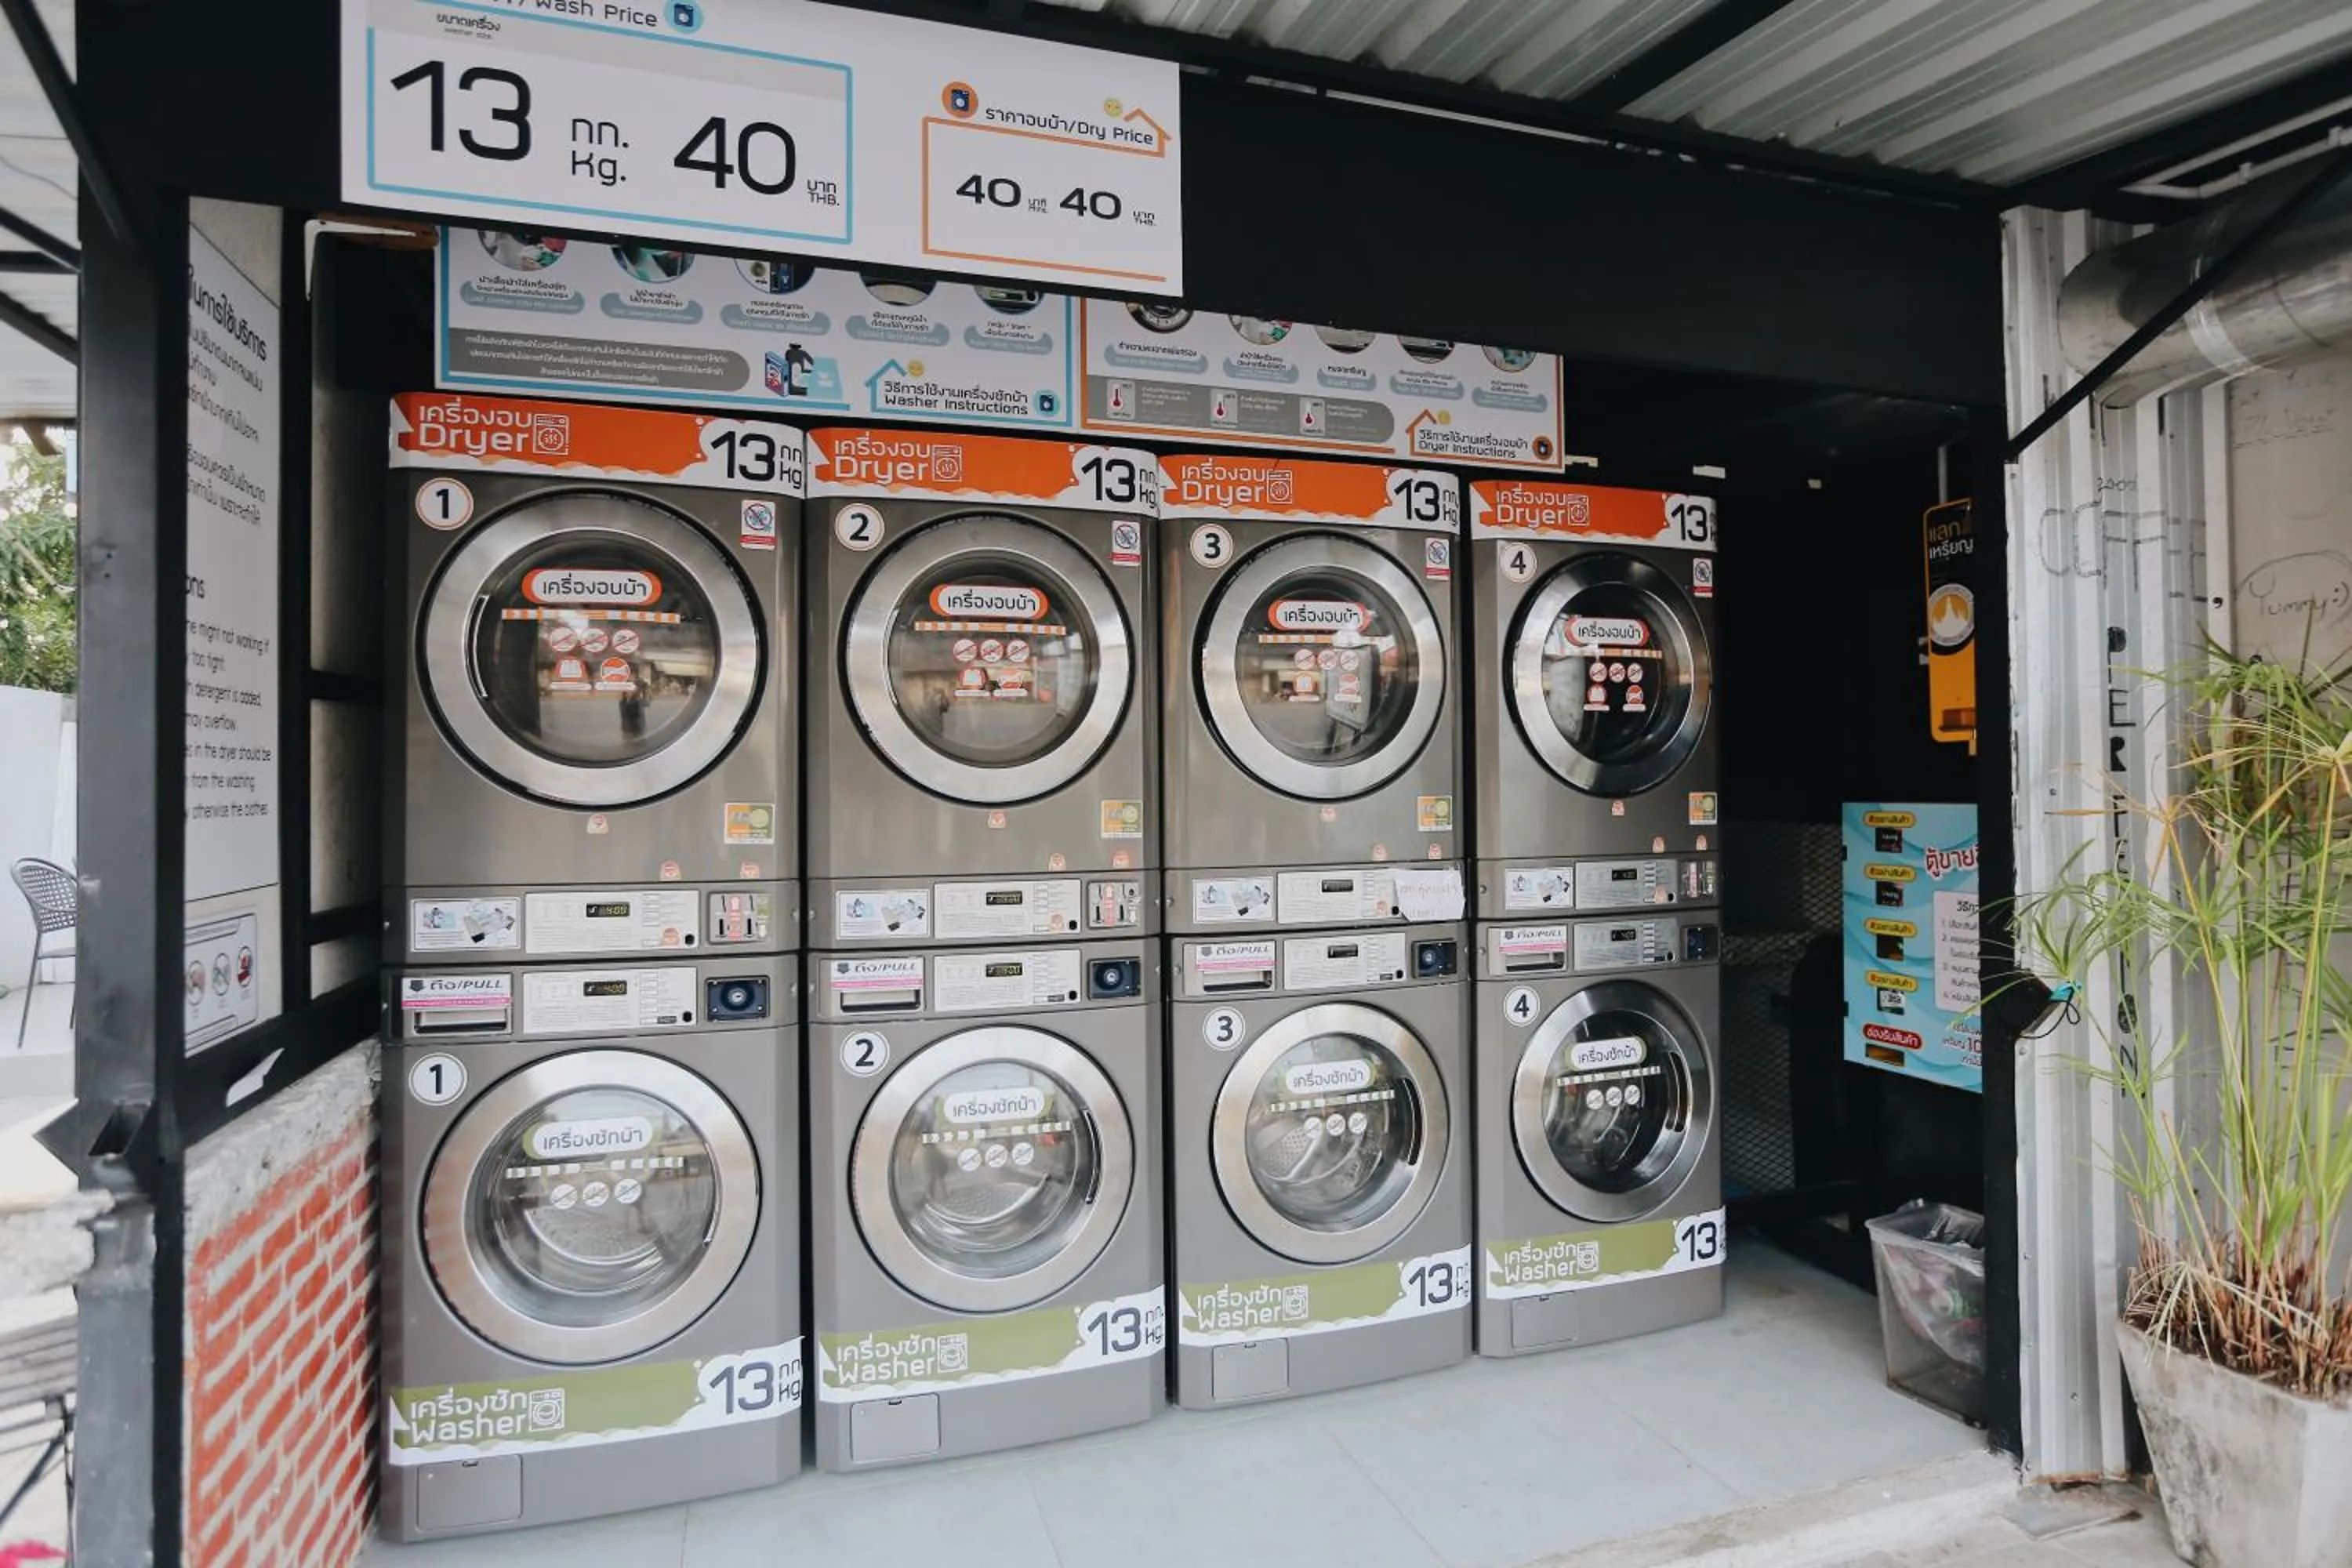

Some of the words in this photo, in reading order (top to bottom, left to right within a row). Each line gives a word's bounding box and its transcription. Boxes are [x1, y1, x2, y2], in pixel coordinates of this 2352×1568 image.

[604, 4, 658, 27] Price
[390, 60, 532, 162] 13
[572, 118, 629, 149] กก.
[1113, 126, 1153, 145] Price
[572, 150, 626, 187] Kg.
[674, 116, 797, 195] 40
[807, 180, 837, 194] บาท
[808, 192, 840, 206] THB.
[956, 174, 1022, 208] 40
[1059, 187, 1122, 220] 40
[884, 379, 1028, 403] วิธีการใช้งานเครื่องซักผ้า
[419, 397, 533, 428] เครื่องอบ
[884, 396, 938, 408] Washer
[945, 399, 1028, 416] Instructions
[419, 422, 530, 456] Dryer
[835, 433, 931, 457] เครื่องอบ
[1419, 440, 1449, 454] Dryer
[1452, 445, 1516, 459] Instructions
[711, 431, 775, 483] 13
[835, 455, 927, 485] Dryer
[1182, 459, 1266, 482] เครื่องอบ
[1081, 457, 1136, 503] 13
[1182, 481, 1264, 506] Dryer
[436, 488, 450, 519] 1
[1394, 478, 1439, 522] 13
[1496, 483, 1566, 506] เครื่องอบ
[849, 513, 869, 542] 2
[1496, 504, 1566, 528] Dryer
[1671, 503, 1708, 542] 13
[1929, 521, 1961, 542] แลก
[1205, 533, 1221, 560] 3
[1929, 538, 1973, 561] เหรียญ
[1510, 551, 1526, 574] 4
[543, 572, 648, 597] เครื่องอบผ้า
[947, 590, 1036, 612] เครื่องอบผ้า
[1284, 604, 1361, 624] เครื่องอบผ้า
[1926, 844, 1980, 877] ตู้ขาย
[1514, 994, 1530, 1018] 4
[1216, 1016, 1233, 1041] 3
[855, 1039, 874, 1066] 2
[429, 1064, 443, 1094] 1
[953, 1095, 1037, 1117] เครื่องซักผ้า
[543, 1125, 643, 1151] เครื่องซักผ้า
[1504, 1240, 1577, 1265] เครื่องซัก
[1682, 1221, 1717, 1261] 13
[1409, 1262, 1453, 1307] 13
[1504, 1260, 1576, 1283] Washer
[1197, 1283, 1282, 1308] เครื่องซัก
[1197, 1305, 1282, 1330] Washer
[1087, 1307, 1141, 1356] 13
[837, 1333, 937, 1362] เครื่องซัก
[837, 1356, 935, 1385] Washer
[710, 1361, 775, 1414] 13
[410, 1387, 528, 1418] เครื่องซัก
[410, 1412, 526, 1444] Washer
